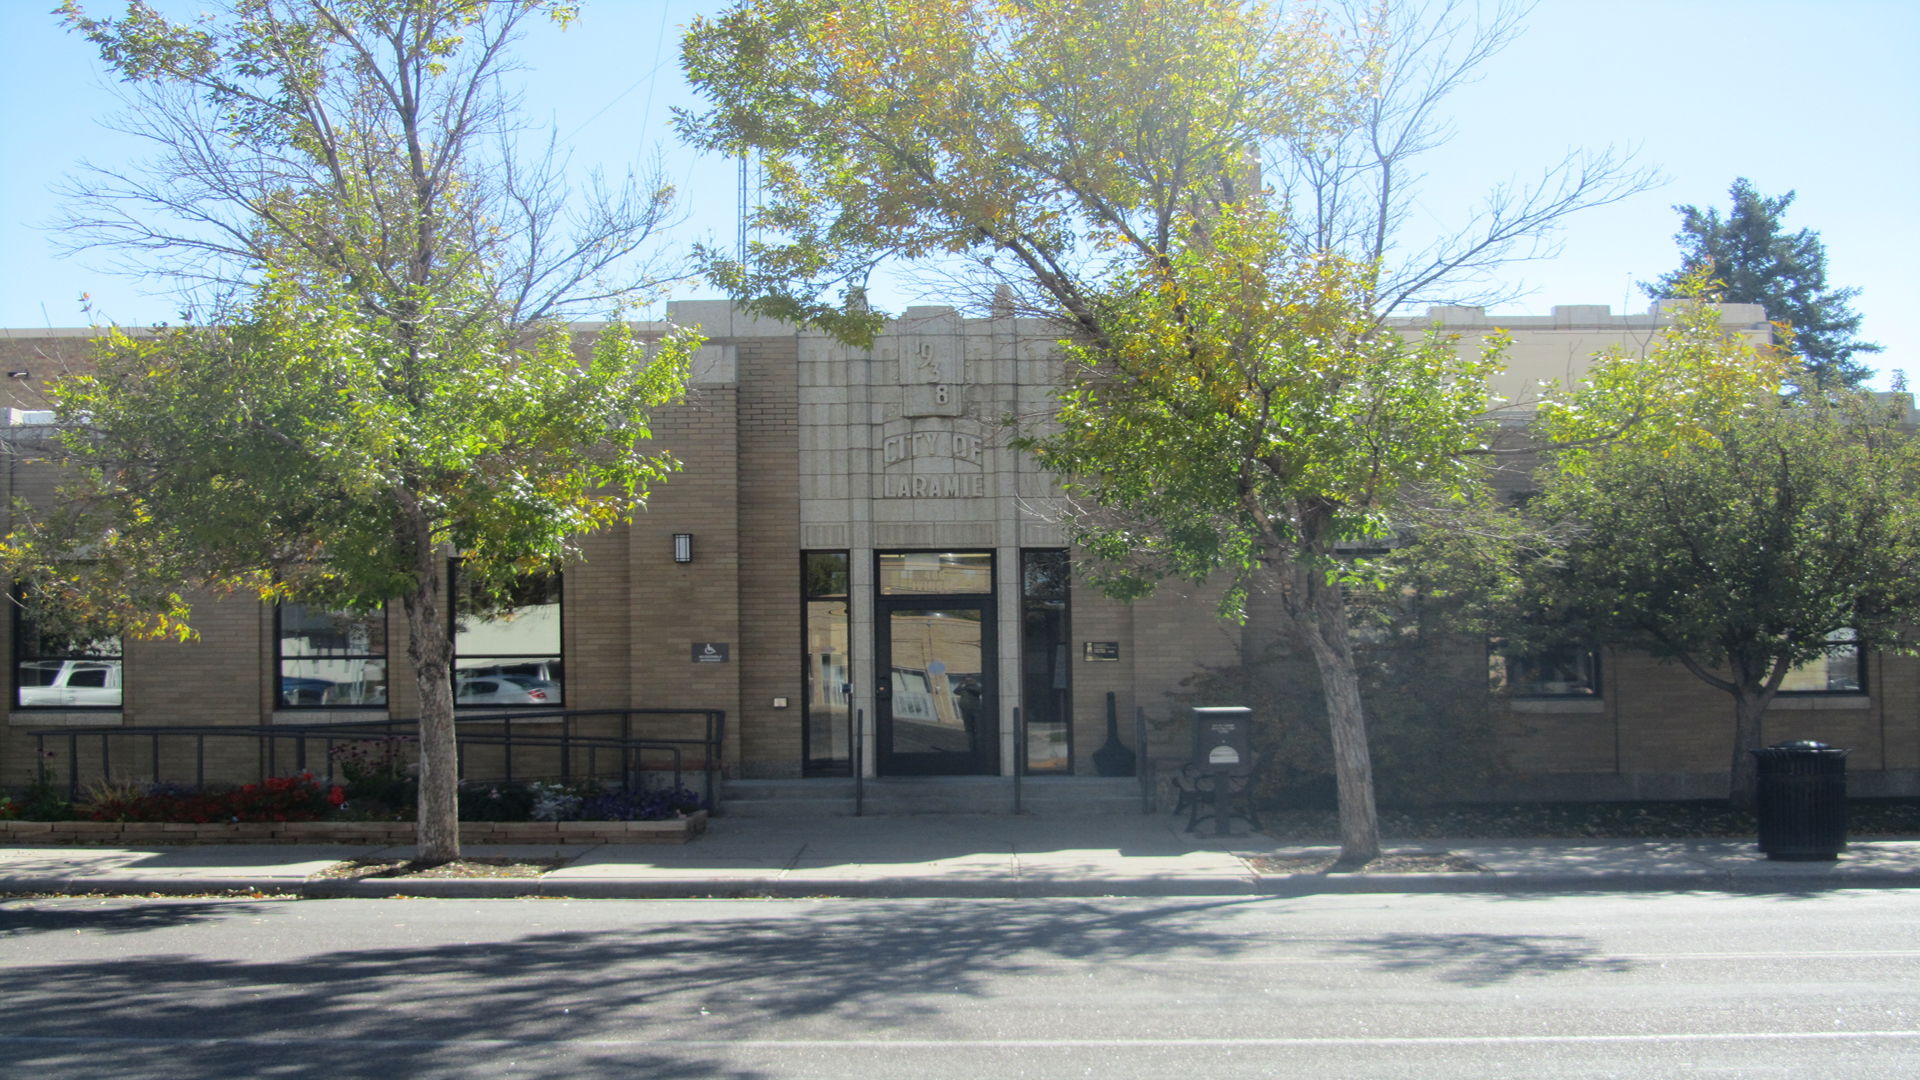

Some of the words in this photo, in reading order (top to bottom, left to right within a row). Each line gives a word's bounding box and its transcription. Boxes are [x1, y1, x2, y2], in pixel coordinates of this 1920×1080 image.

[884, 432, 938, 463] CITY
[952, 435, 983, 462] OF
[884, 474, 983, 497] LARAMIE
